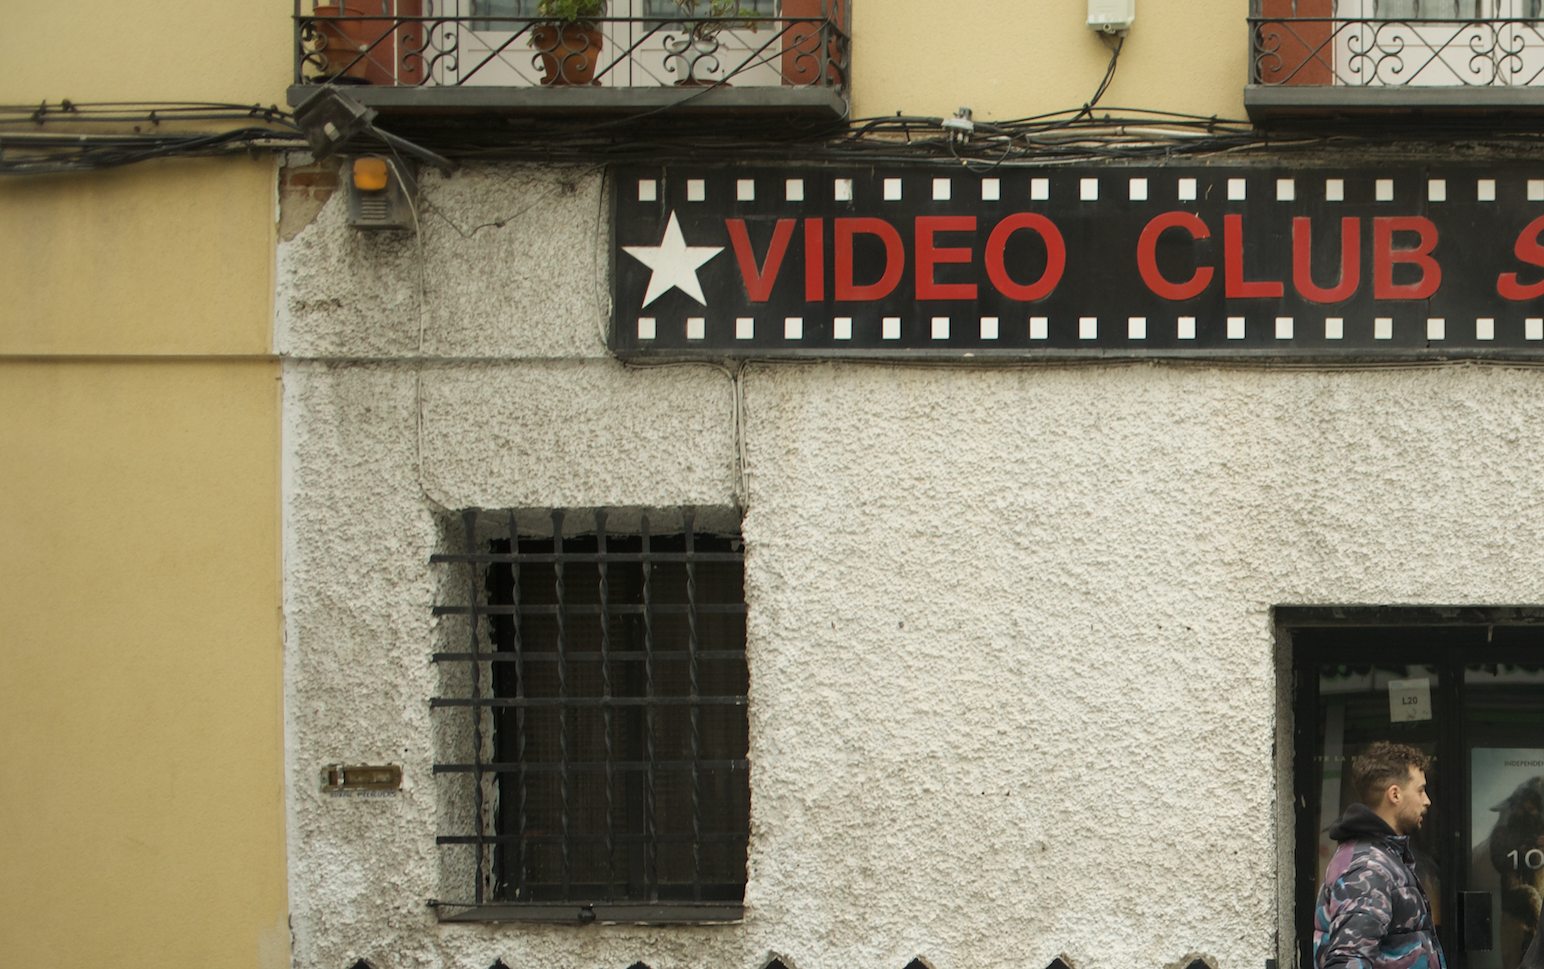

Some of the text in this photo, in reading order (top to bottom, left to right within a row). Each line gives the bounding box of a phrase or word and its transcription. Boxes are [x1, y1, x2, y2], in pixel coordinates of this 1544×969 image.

[724, 212, 1067, 303] VIDEO
[1136, 211, 1443, 304] CLUB
[1402, 696, 1418, 705] L20
